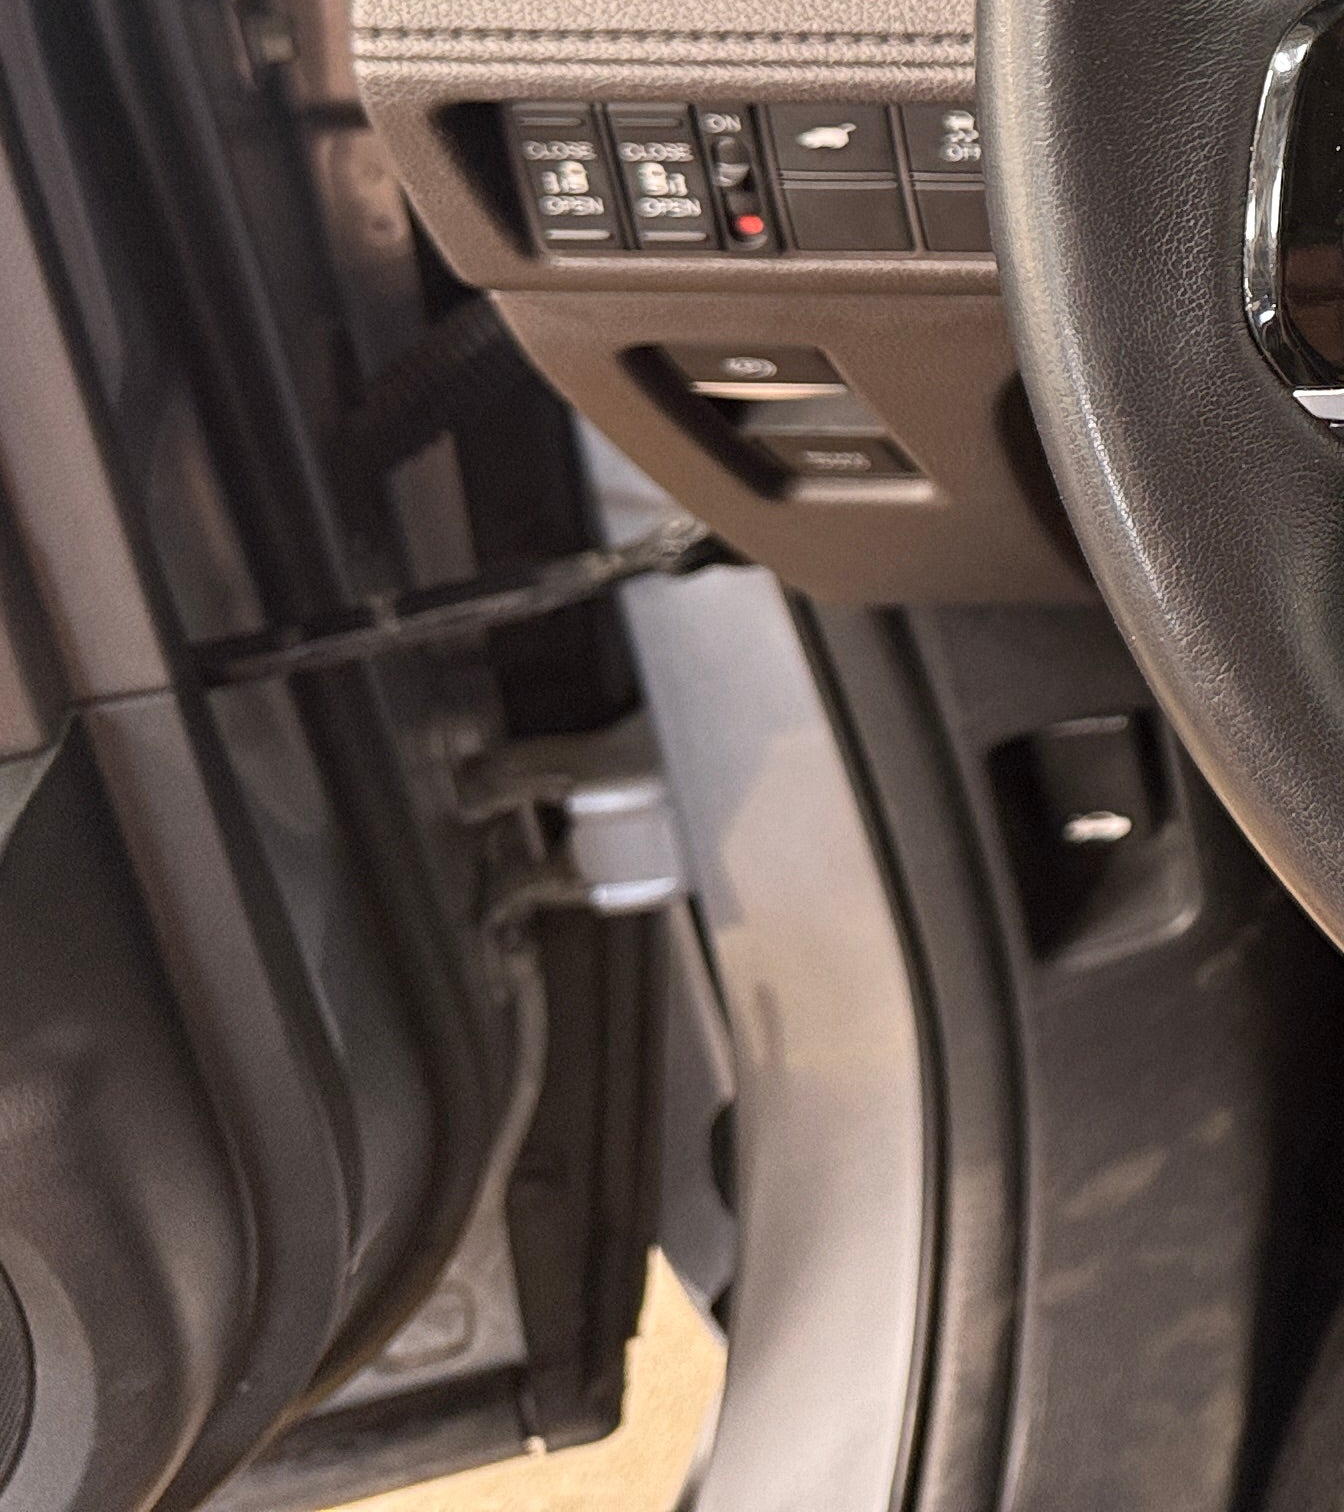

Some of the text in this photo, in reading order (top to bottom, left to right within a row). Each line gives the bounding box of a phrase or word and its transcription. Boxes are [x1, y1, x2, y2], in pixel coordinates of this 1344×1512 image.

[704, 113, 742, 134] ON
[525, 141, 597, 161] CLOSE
[621, 142, 694, 162] CLOSE
[541, 195, 604, 216] OPEN
[638, 196, 702, 217] OPEN
